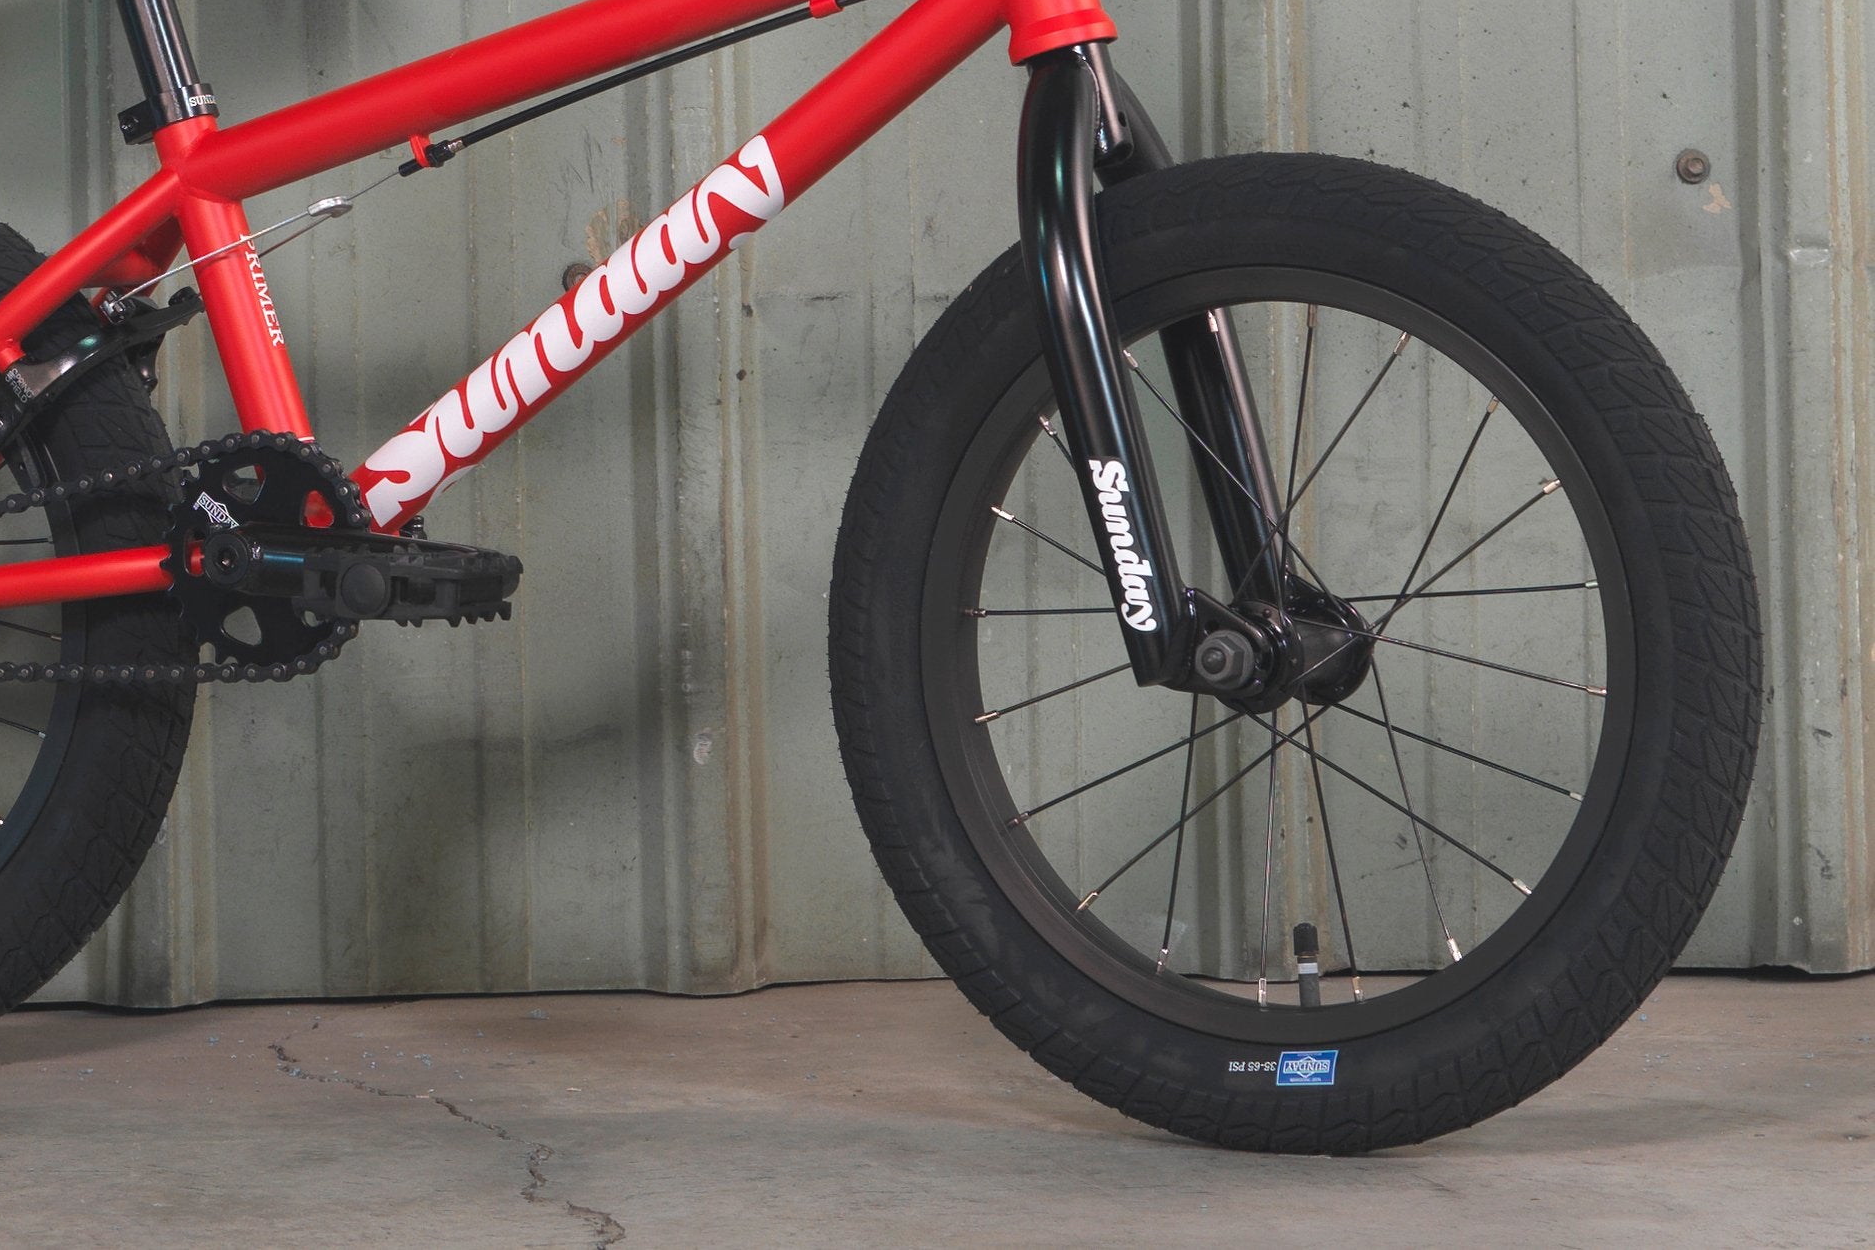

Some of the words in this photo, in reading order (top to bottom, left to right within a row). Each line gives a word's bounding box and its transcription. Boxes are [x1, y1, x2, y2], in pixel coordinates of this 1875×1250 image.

[239, 233, 285, 347] PRIMER
[1088, 459, 1157, 632] Sunday
[1228, 1061, 1246, 1072] PSI
[1284, 1060, 1330, 1072] SUNDAY
